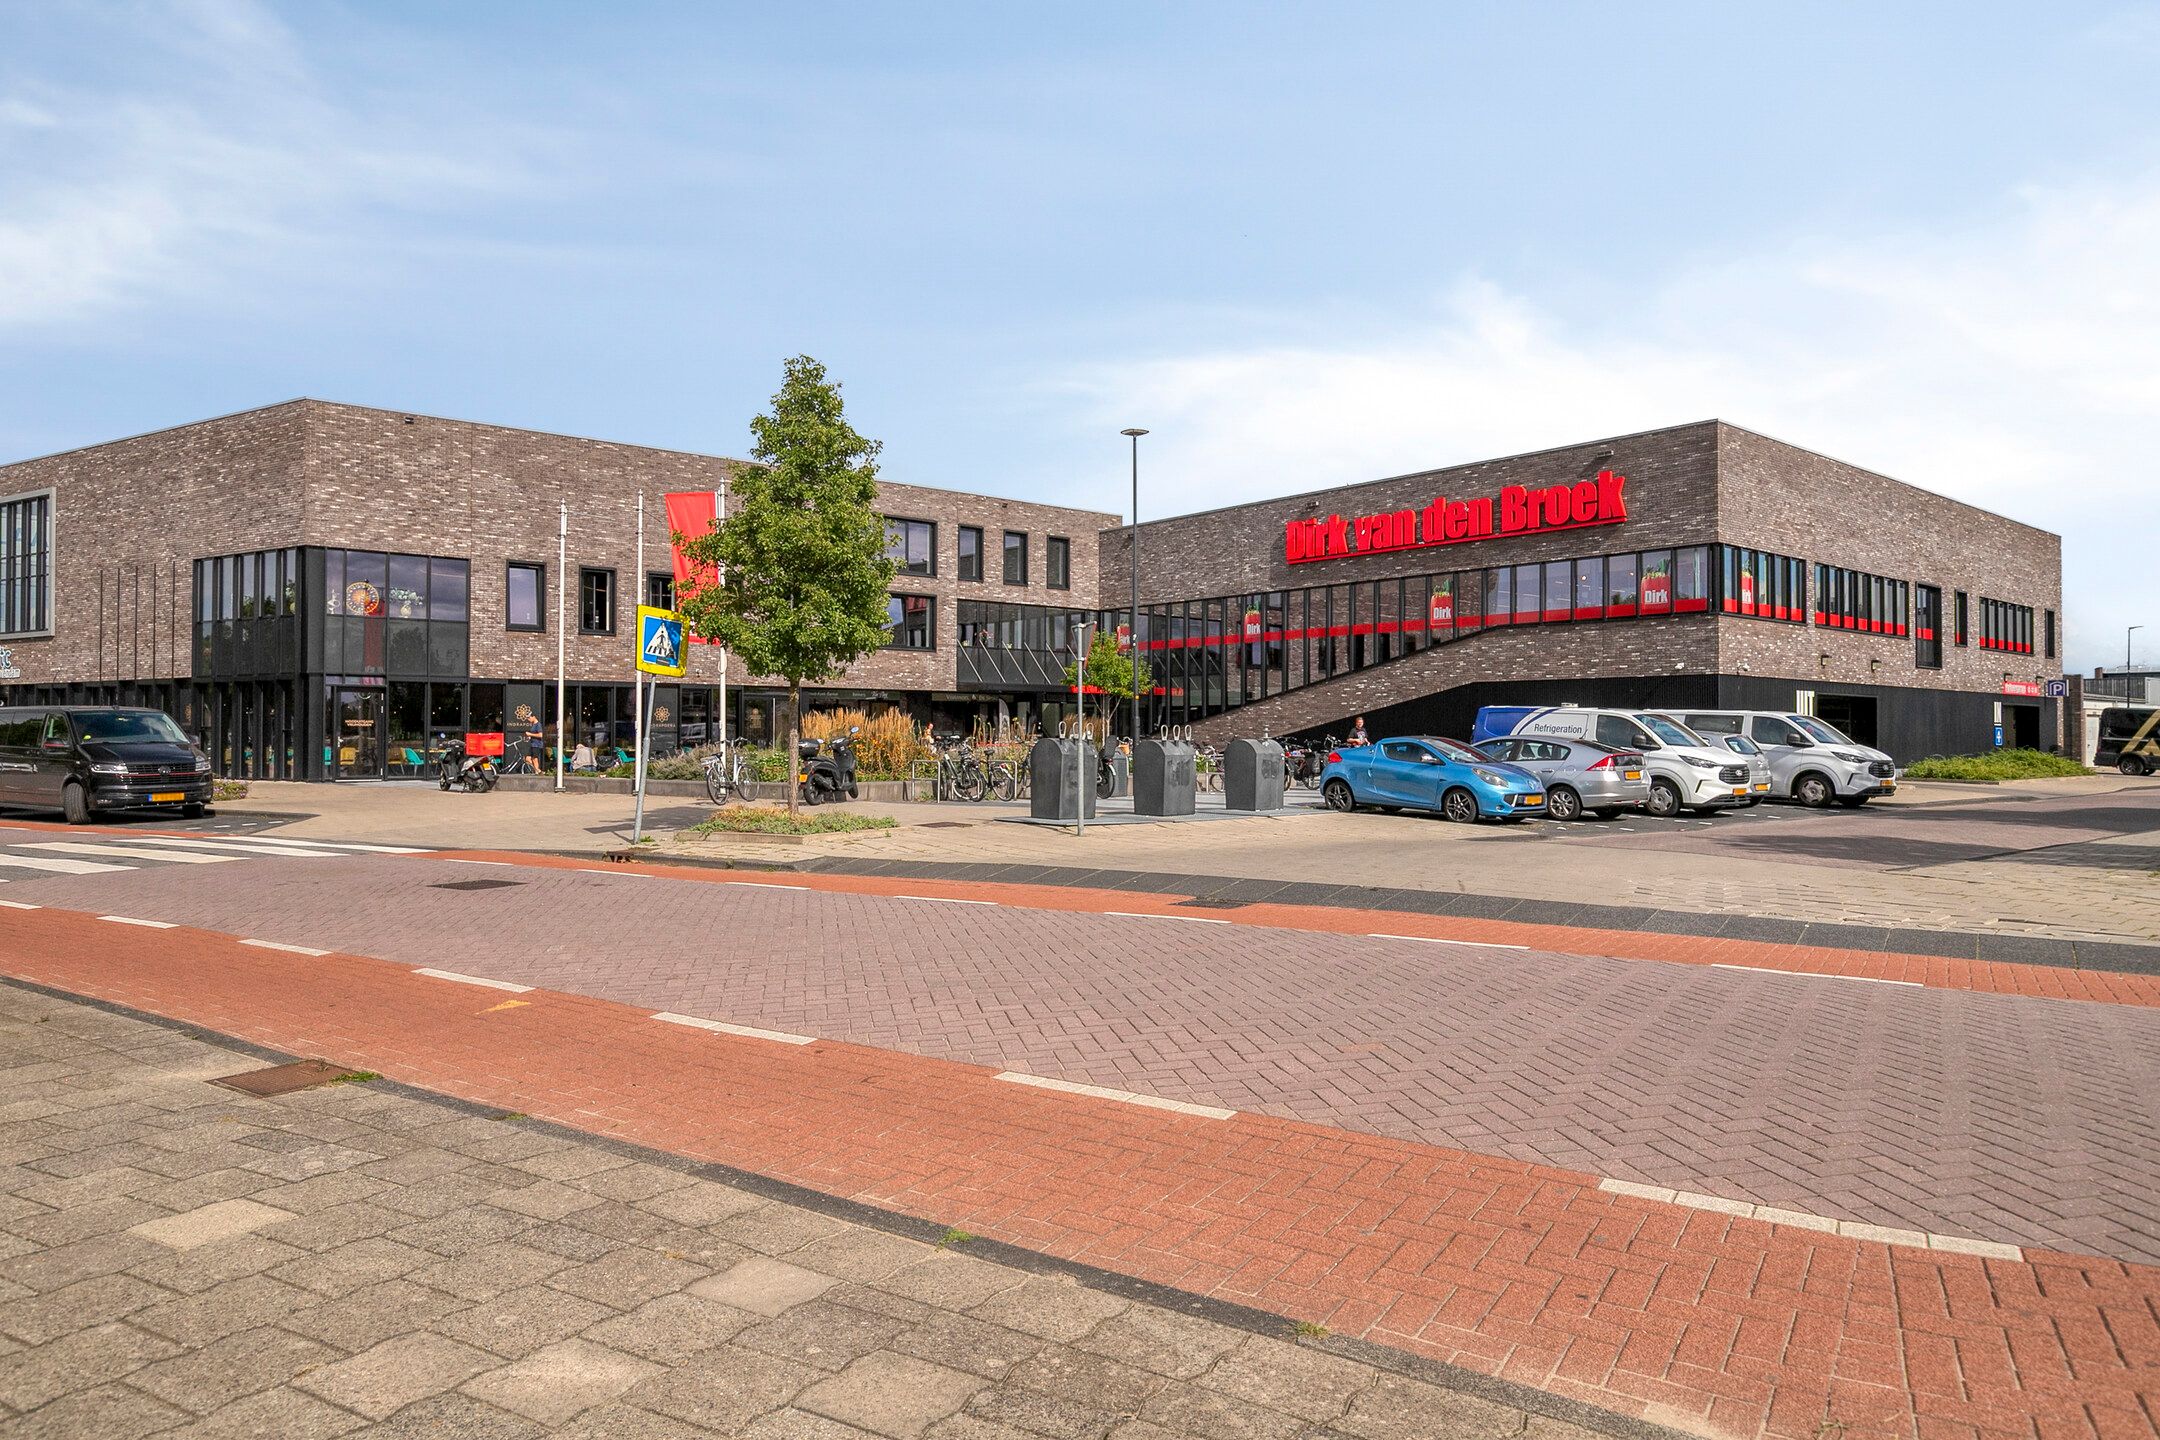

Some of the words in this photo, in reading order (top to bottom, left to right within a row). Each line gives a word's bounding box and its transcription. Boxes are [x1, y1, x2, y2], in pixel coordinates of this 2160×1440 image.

[1286, 514, 1349, 560] Dirk
[1354, 509, 1416, 550] van
[1422, 496, 1493, 543] den
[1501, 470, 1627, 533] Broek
[1645, 589, 1668, 604] Dirk
[1433, 606, 1451, 620] Dirk
[1246, 623, 1260, 635] Dirk
[2053, 684, 2063, 696] P
[1534, 723, 1582, 735] Refrigeration
